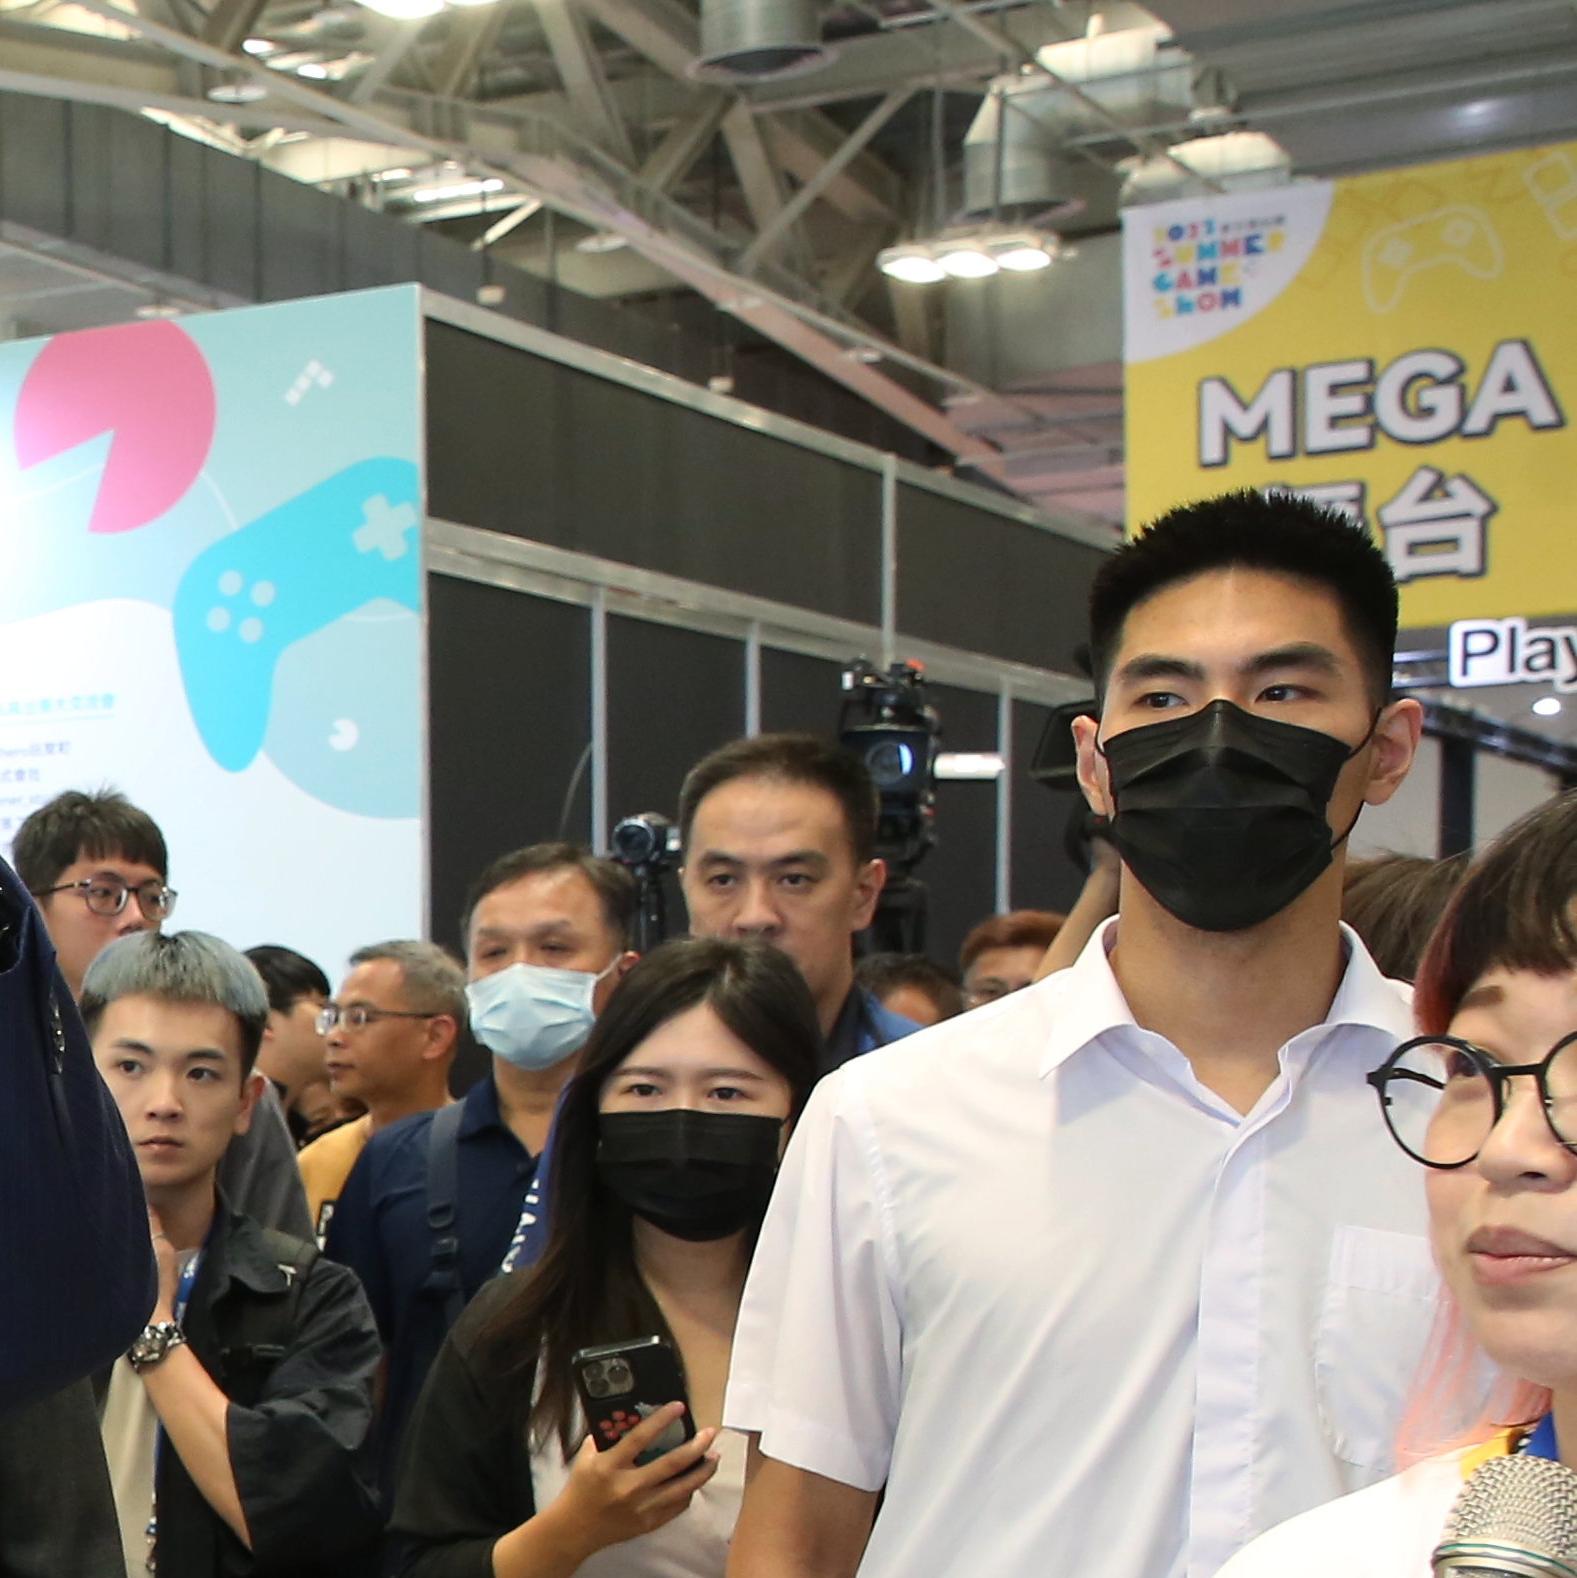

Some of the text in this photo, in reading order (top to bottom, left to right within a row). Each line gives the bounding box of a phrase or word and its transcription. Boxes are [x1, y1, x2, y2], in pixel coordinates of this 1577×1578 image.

[1152, 231, 1285, 269] SUMMER
[1153, 263, 1242, 292] GAME
[1197, 338, 1565, 468] MEGA
